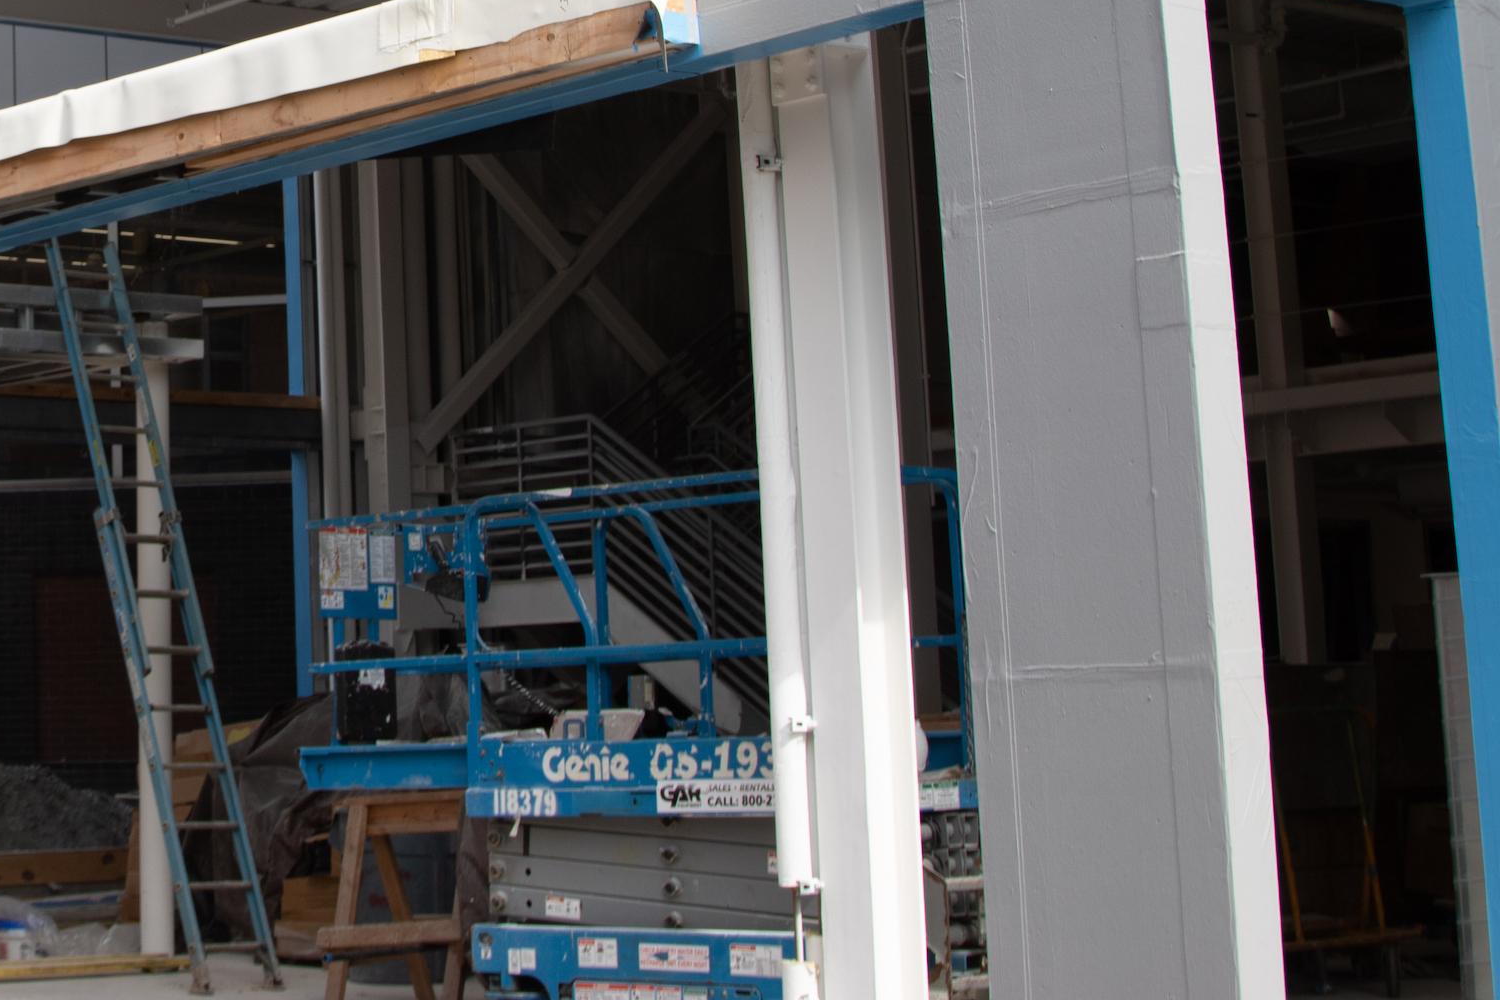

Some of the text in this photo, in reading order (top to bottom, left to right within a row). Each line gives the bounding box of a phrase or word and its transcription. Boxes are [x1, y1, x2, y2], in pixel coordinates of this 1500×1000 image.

[542, 745, 630, 783] Genie
[740, 783, 775, 792] RENTALS
[494, 788, 557, 817] 118379
[707, 793, 776, 807] CALL: 800-2
